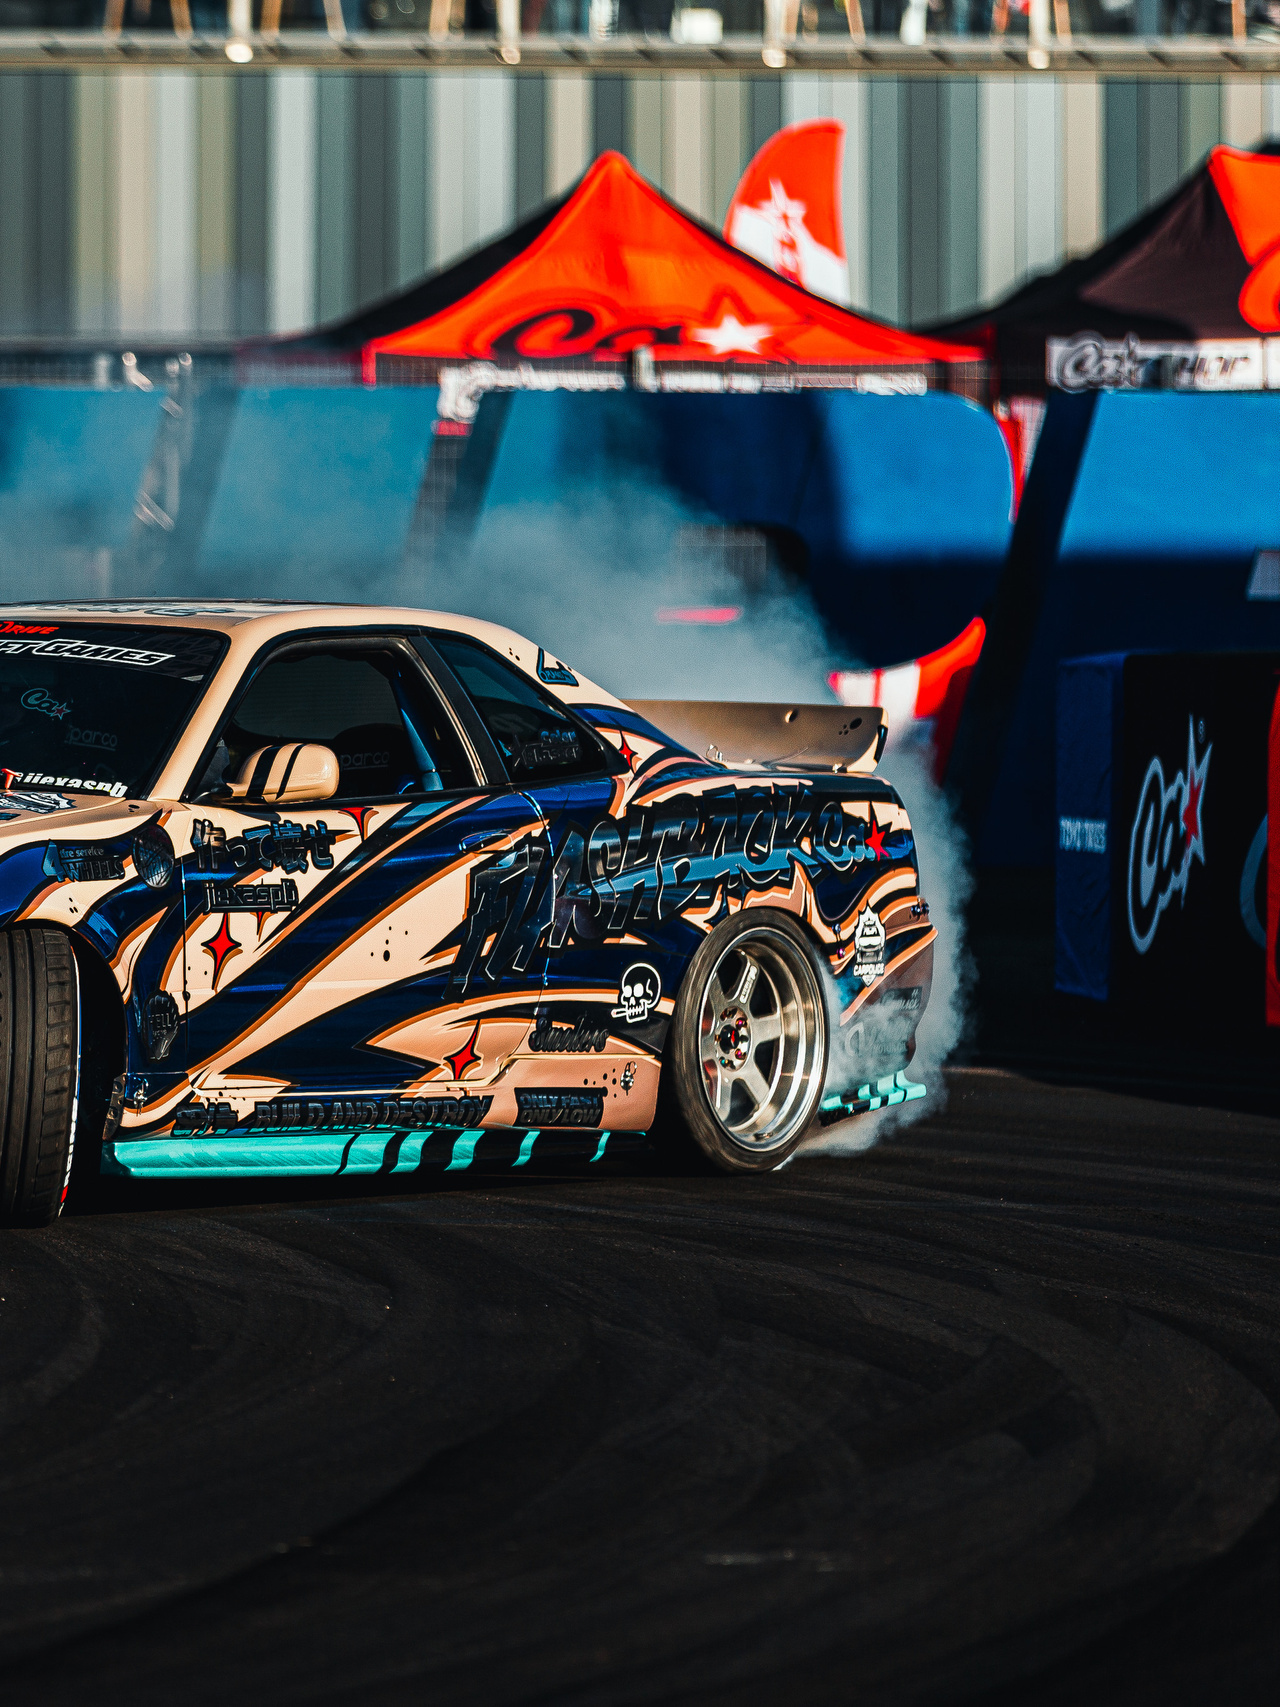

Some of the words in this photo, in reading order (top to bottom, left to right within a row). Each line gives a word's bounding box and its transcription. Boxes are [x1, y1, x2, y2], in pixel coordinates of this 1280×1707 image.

[33, 639, 176, 666] GAMES
[67, 725, 119, 748] parco
[337, 750, 390, 770] parco
[63, 857, 125, 882] WHEELS
[529, 1017, 609, 1053] Smokers
[328, 1099, 379, 1131] AND
[381, 1095, 493, 1130] DESTROY
[519, 1108, 559, 1125] ONLY
[561, 1107, 601, 1124] LOW
